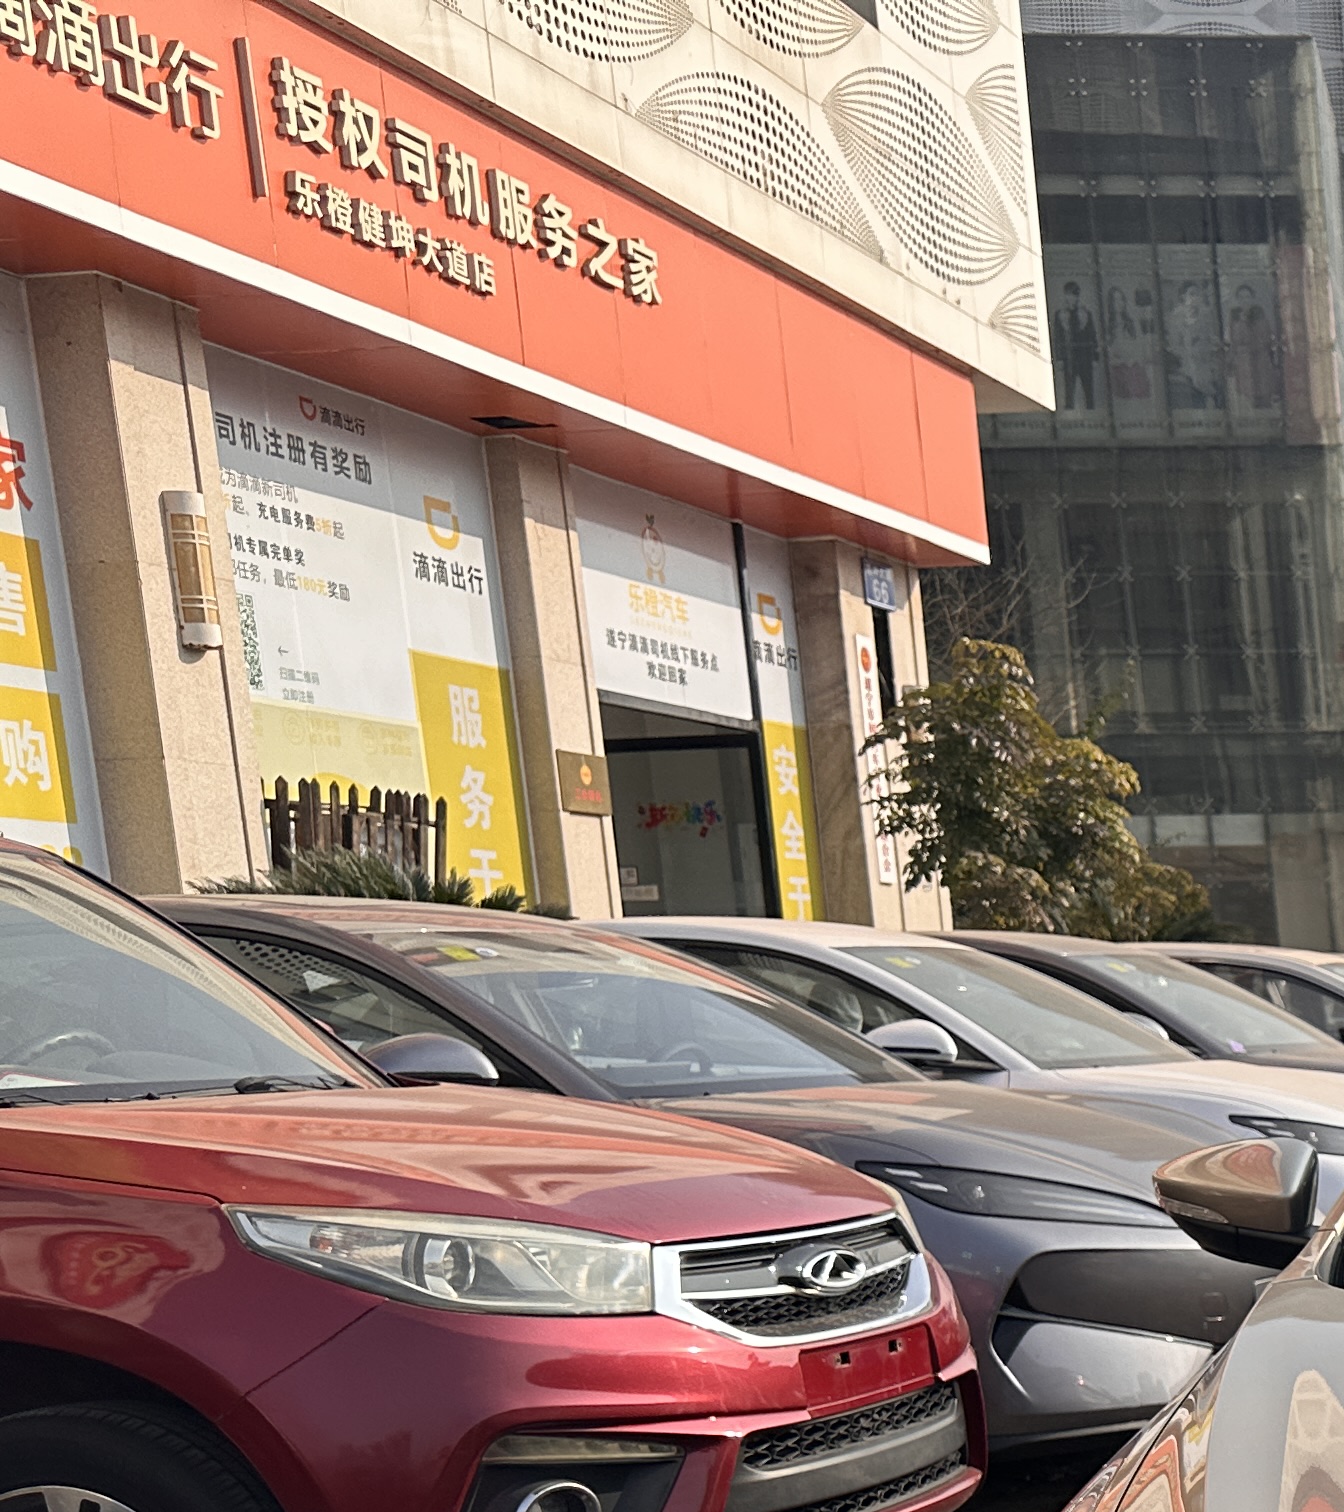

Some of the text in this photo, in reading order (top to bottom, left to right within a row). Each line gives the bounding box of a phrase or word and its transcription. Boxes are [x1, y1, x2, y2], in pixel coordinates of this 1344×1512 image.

[275, 57, 662, 304] 授权司机服务之家
[290, 171, 496, 296] 乐橙健坤大道店
[319, 405, 365, 436] 滴滴出行
[215, 411, 372, 485] 司机注册有奖励
[413, 550, 484, 596] 滴滴出行
[873, 579, 889, 604] 66
[628, 582, 690, 624] 乐橙汽车
[752, 640, 798, 671] 滴滴出行
